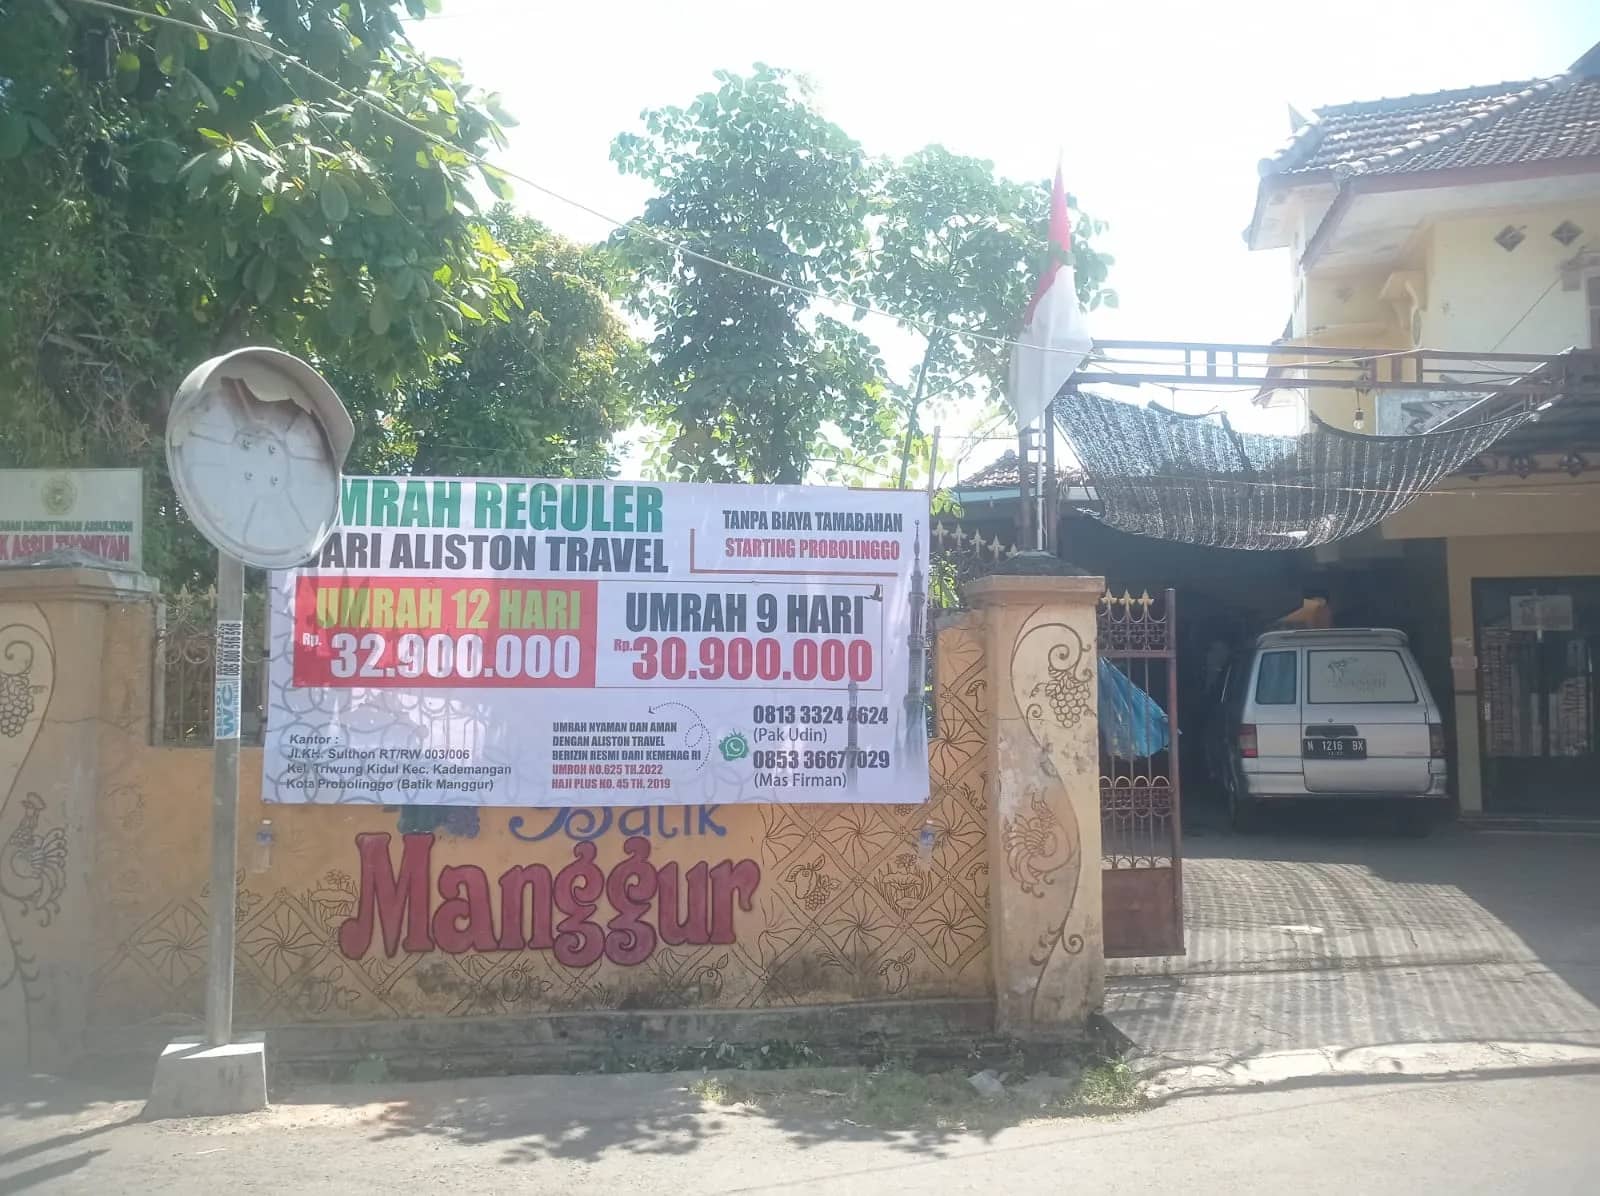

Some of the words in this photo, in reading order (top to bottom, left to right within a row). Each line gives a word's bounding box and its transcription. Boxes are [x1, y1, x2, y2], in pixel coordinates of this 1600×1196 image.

[336, 478, 461, 528] MRAH
[474, 480, 662, 532] REGULER
[722, 510, 768, 531] TANPA
[771, 511, 812, 532] BIAYA
[815, 511, 903, 533] TAMABAHAN
[303, 532, 382, 568] ARI
[390, 533, 538, 571] ALISTON
[545, 535, 669, 574] TRAVEL
[725, 537, 796, 559] STARTING
[799, 538, 900, 560] PROBOLINGGO
[315, 587, 441, 629] UMRAH
[451, 589, 488, 629] 12
[501, 589, 581, 630] HARI
[625, 592, 747, 633] UMRAH
[756, 593, 777, 632] 9
[787, 593, 864, 634] HARI
[330, 633, 581, 679] 32.900.000
[633, 636, 873, 682] 30.900.000
[222, 684, 234, 737] WC
[753, 705, 796, 724] 0813
[800, 705, 844, 724] 3324
[847, 706, 889, 724] 4624
[552, 722, 587, 732] UMRAH
[589, 722, 627, 732] NYAMAN
[629, 722, 648, 732] DAN
[650, 722, 677, 732] AMAN
[753, 727, 784, 743] (Pak
[789, 727, 827, 744] Udin)
[289, 734, 332, 744] Kantor
[552, 736, 590, 746] DENGAN
[591, 736, 630, 746] ALISTON
[632, 736, 665, 746] TRAVEL
[328, 748, 375, 759] Sulthon
[380, 749, 421, 759] RT/RW
[424, 749, 470, 760] 003/006
[552, 750, 588, 761] BERIZIN
[590, 750, 619, 761] RESMI
[621, 750, 643, 761] DARI
[646, 750, 690, 761] KEMENAG
[691, 750, 702, 761] RI
[753, 750, 799, 769] 0853
[804, 750, 847, 769] 3667
[313, 763, 363, 776] Triwung
[367, 763, 399, 774] Kidul
[403, 764, 429, 774] Kec.
[433, 764, 512, 776] Kademangan
[552, 764, 587, 775] UMROH
[286, 779, 315, 789] Kota
[318, 779, 393, 791] Probolinggo
[397, 779, 432, 792] (Batik
[436, 779, 494, 792] Manggur)
[551, 778, 572, 790] HAJI
[574, 778, 598, 790] PLUS
[647, 778, 671, 790] 2019
[753, 772, 788, 788] (Mas
[793, 772, 847, 788] Firman)
[338, 832, 762, 968] Manggur
